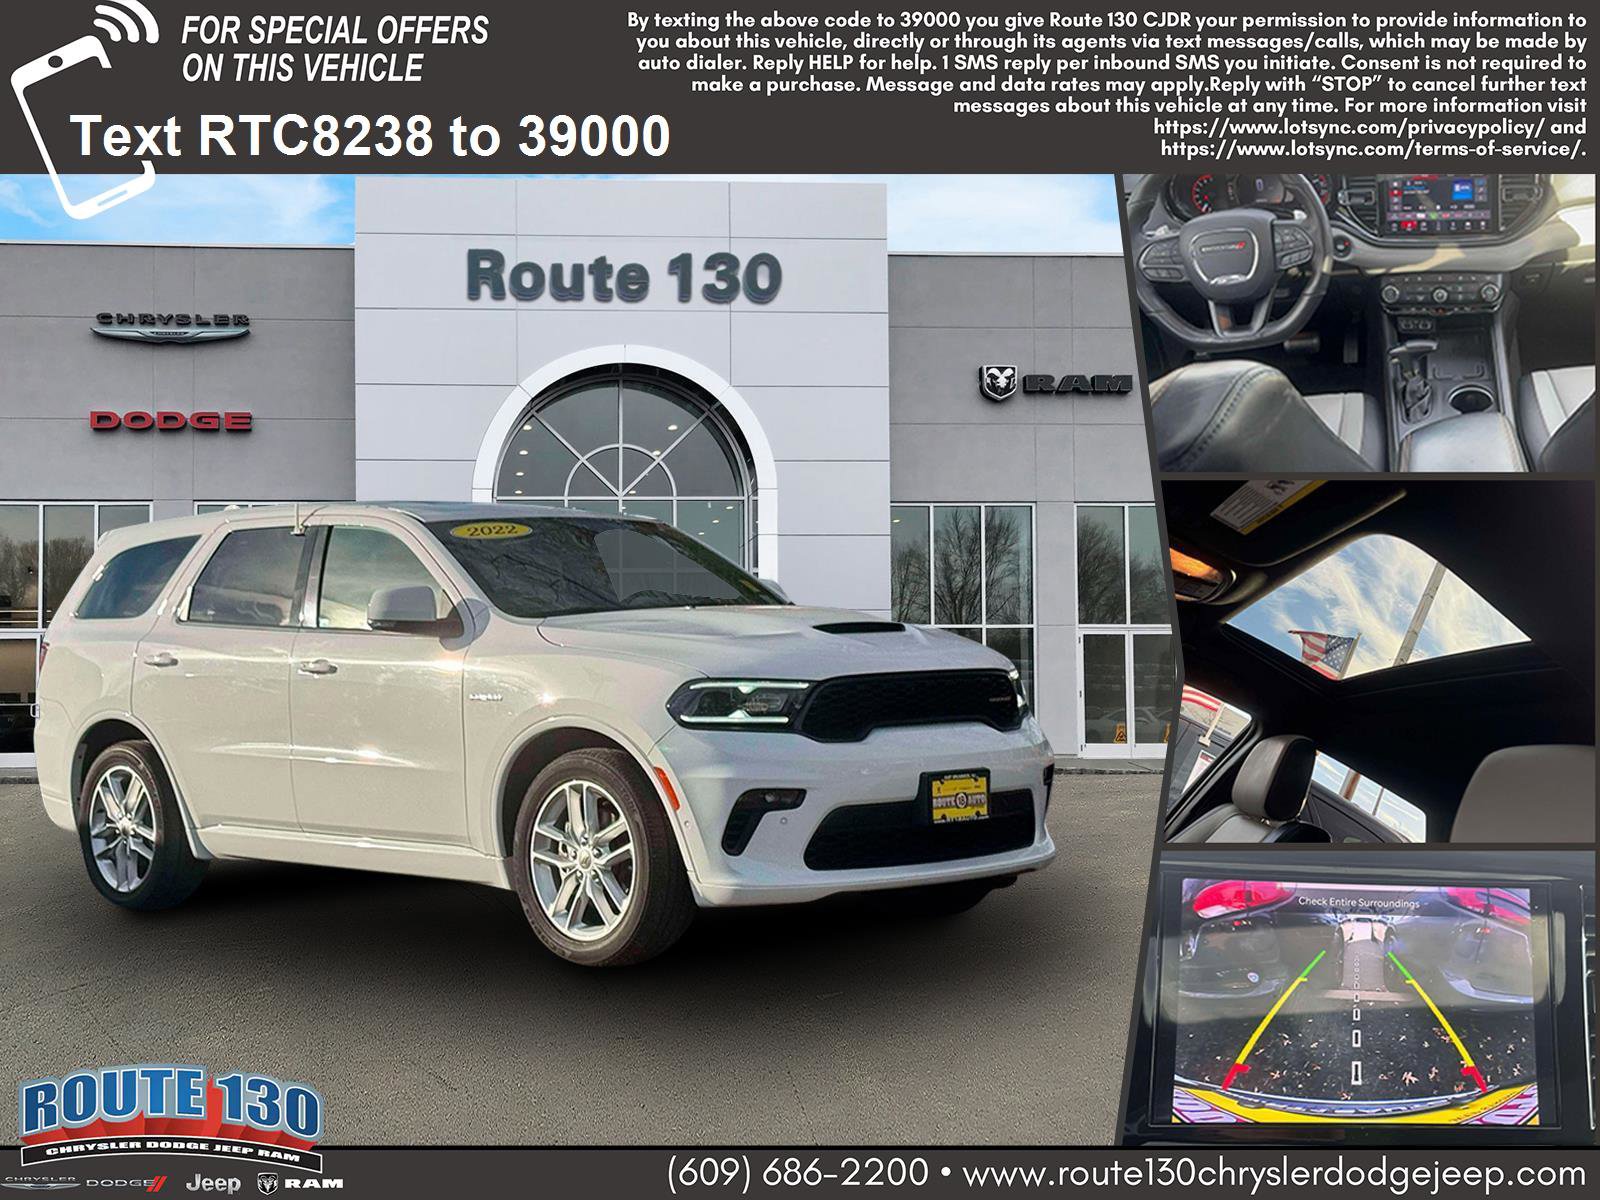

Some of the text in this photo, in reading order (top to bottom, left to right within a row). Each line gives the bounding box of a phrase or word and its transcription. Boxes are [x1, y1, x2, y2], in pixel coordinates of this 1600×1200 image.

[466, 248, 783, 304] Route 130
[96, 312, 250, 326] CHRYSLER
[1022, 374, 1133, 394] RAM
[90, 410, 253, 432] DODGE
[467, 525, 519, 537] 2022
[1298, 896, 1420, 910] Check Entire Surroundings
